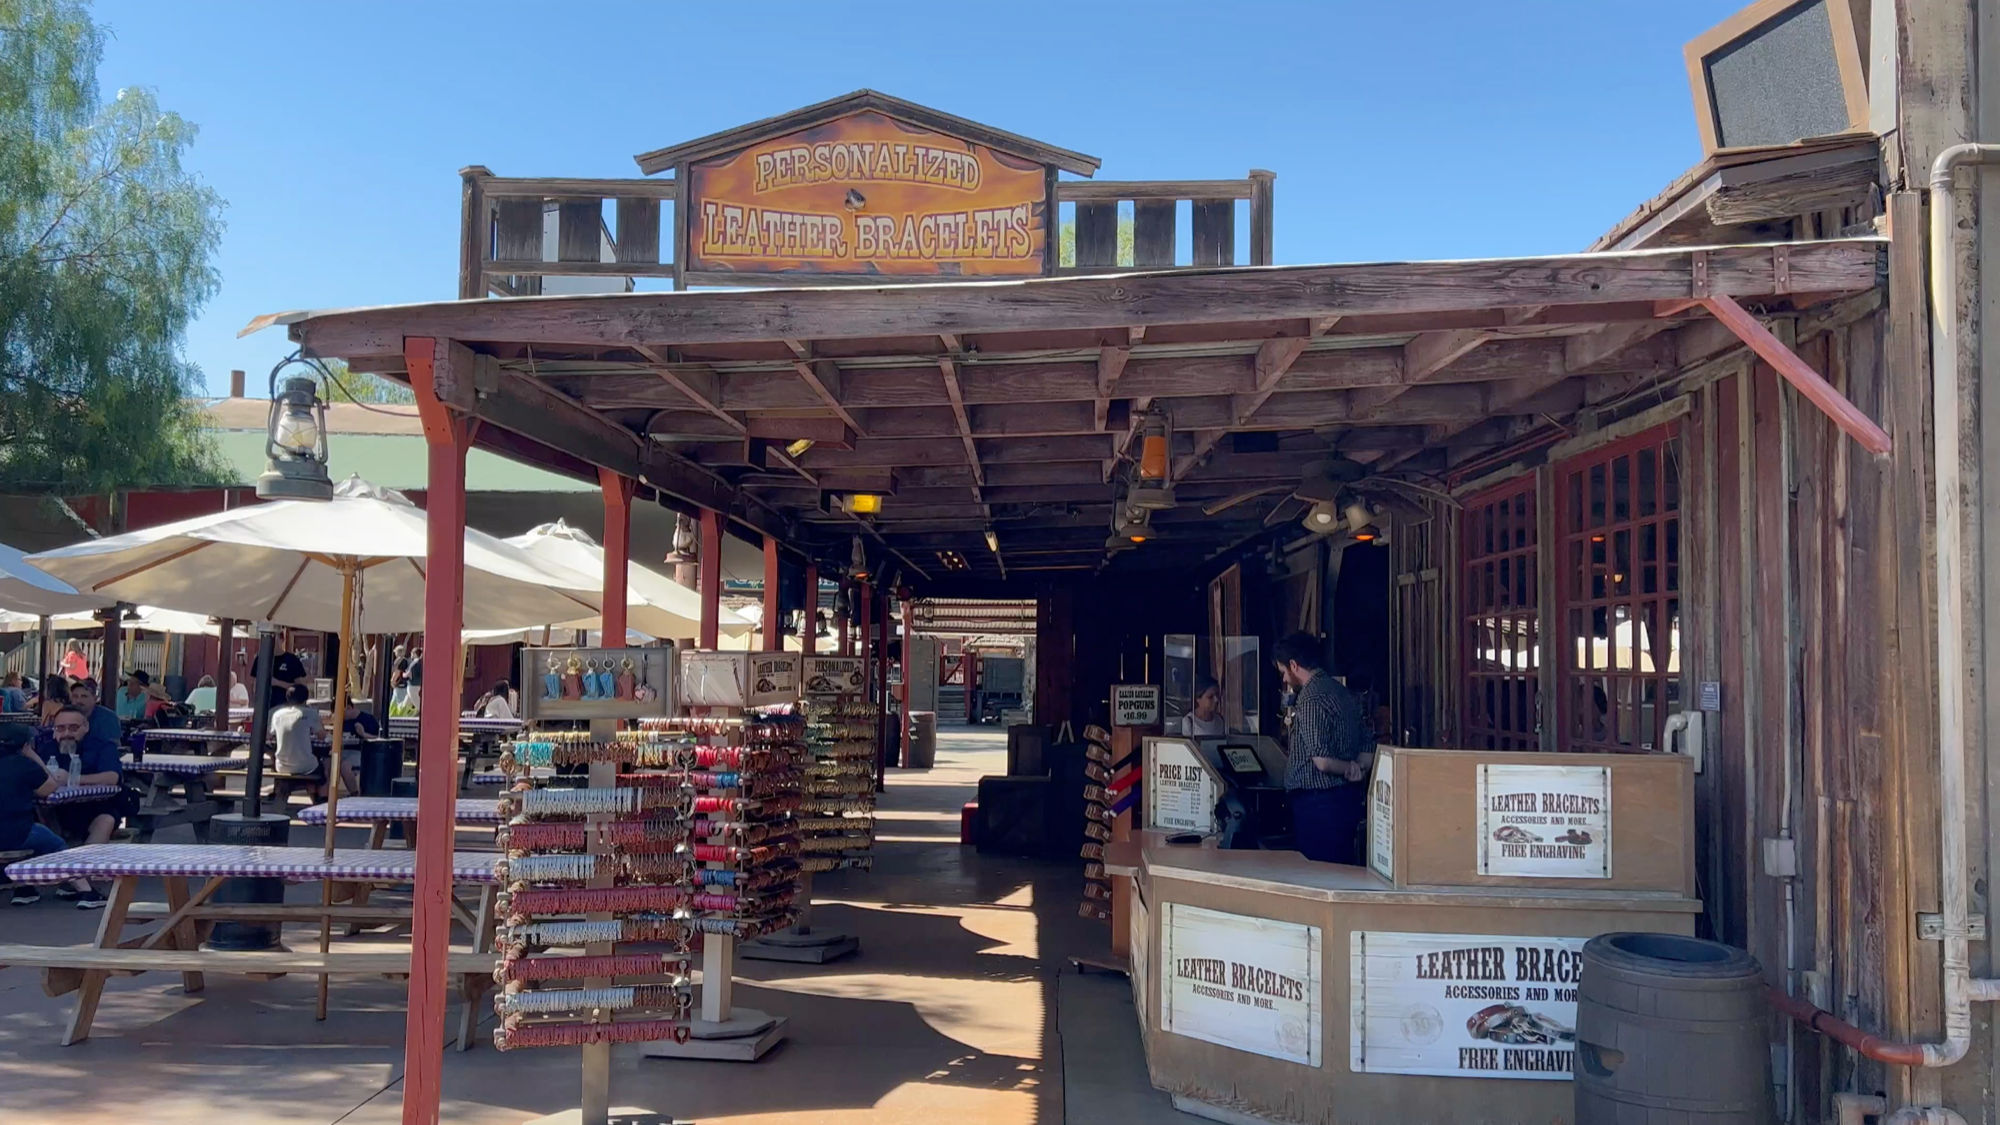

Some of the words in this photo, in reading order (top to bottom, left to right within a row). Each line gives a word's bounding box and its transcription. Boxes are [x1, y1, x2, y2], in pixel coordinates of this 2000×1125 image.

[756, 142, 980, 191] PERSONALIZED
[703, 202, 848, 257] LEATHER
[854, 204, 1031, 258] BRACELETS
[1118, 700, 1155, 710] POPGUNS
[1159, 763, 1182, 780] PRICE
[1185, 765, 1203, 782] LIST
[1491, 793, 1537, 813] LEATHER
[1542, 793, 1600, 815] BRACELETS
[1501, 815, 1548, 825] ACCESSORIES
[1551, 816, 1565, 825] AND
[1501, 844, 1527, 858] FREE
[1530, 845, 1586, 859] ENGRAVING
[1416, 947, 1506, 981] LEATHER
[1516, 947, 1582, 983] BRACE
[1177, 958, 1226, 986] LEATHER
[1231, 962, 1303, 1002] BRACELETS
[1192, 983, 1235, 1002] ACCESSORIES
[1237, 993, 1251, 1006] AND
[1445, 985, 1520, 1001] ACCESSORIES
[1526, 987, 1549, 1001] AND
[1458, 1047, 1499, 1070] FREE
